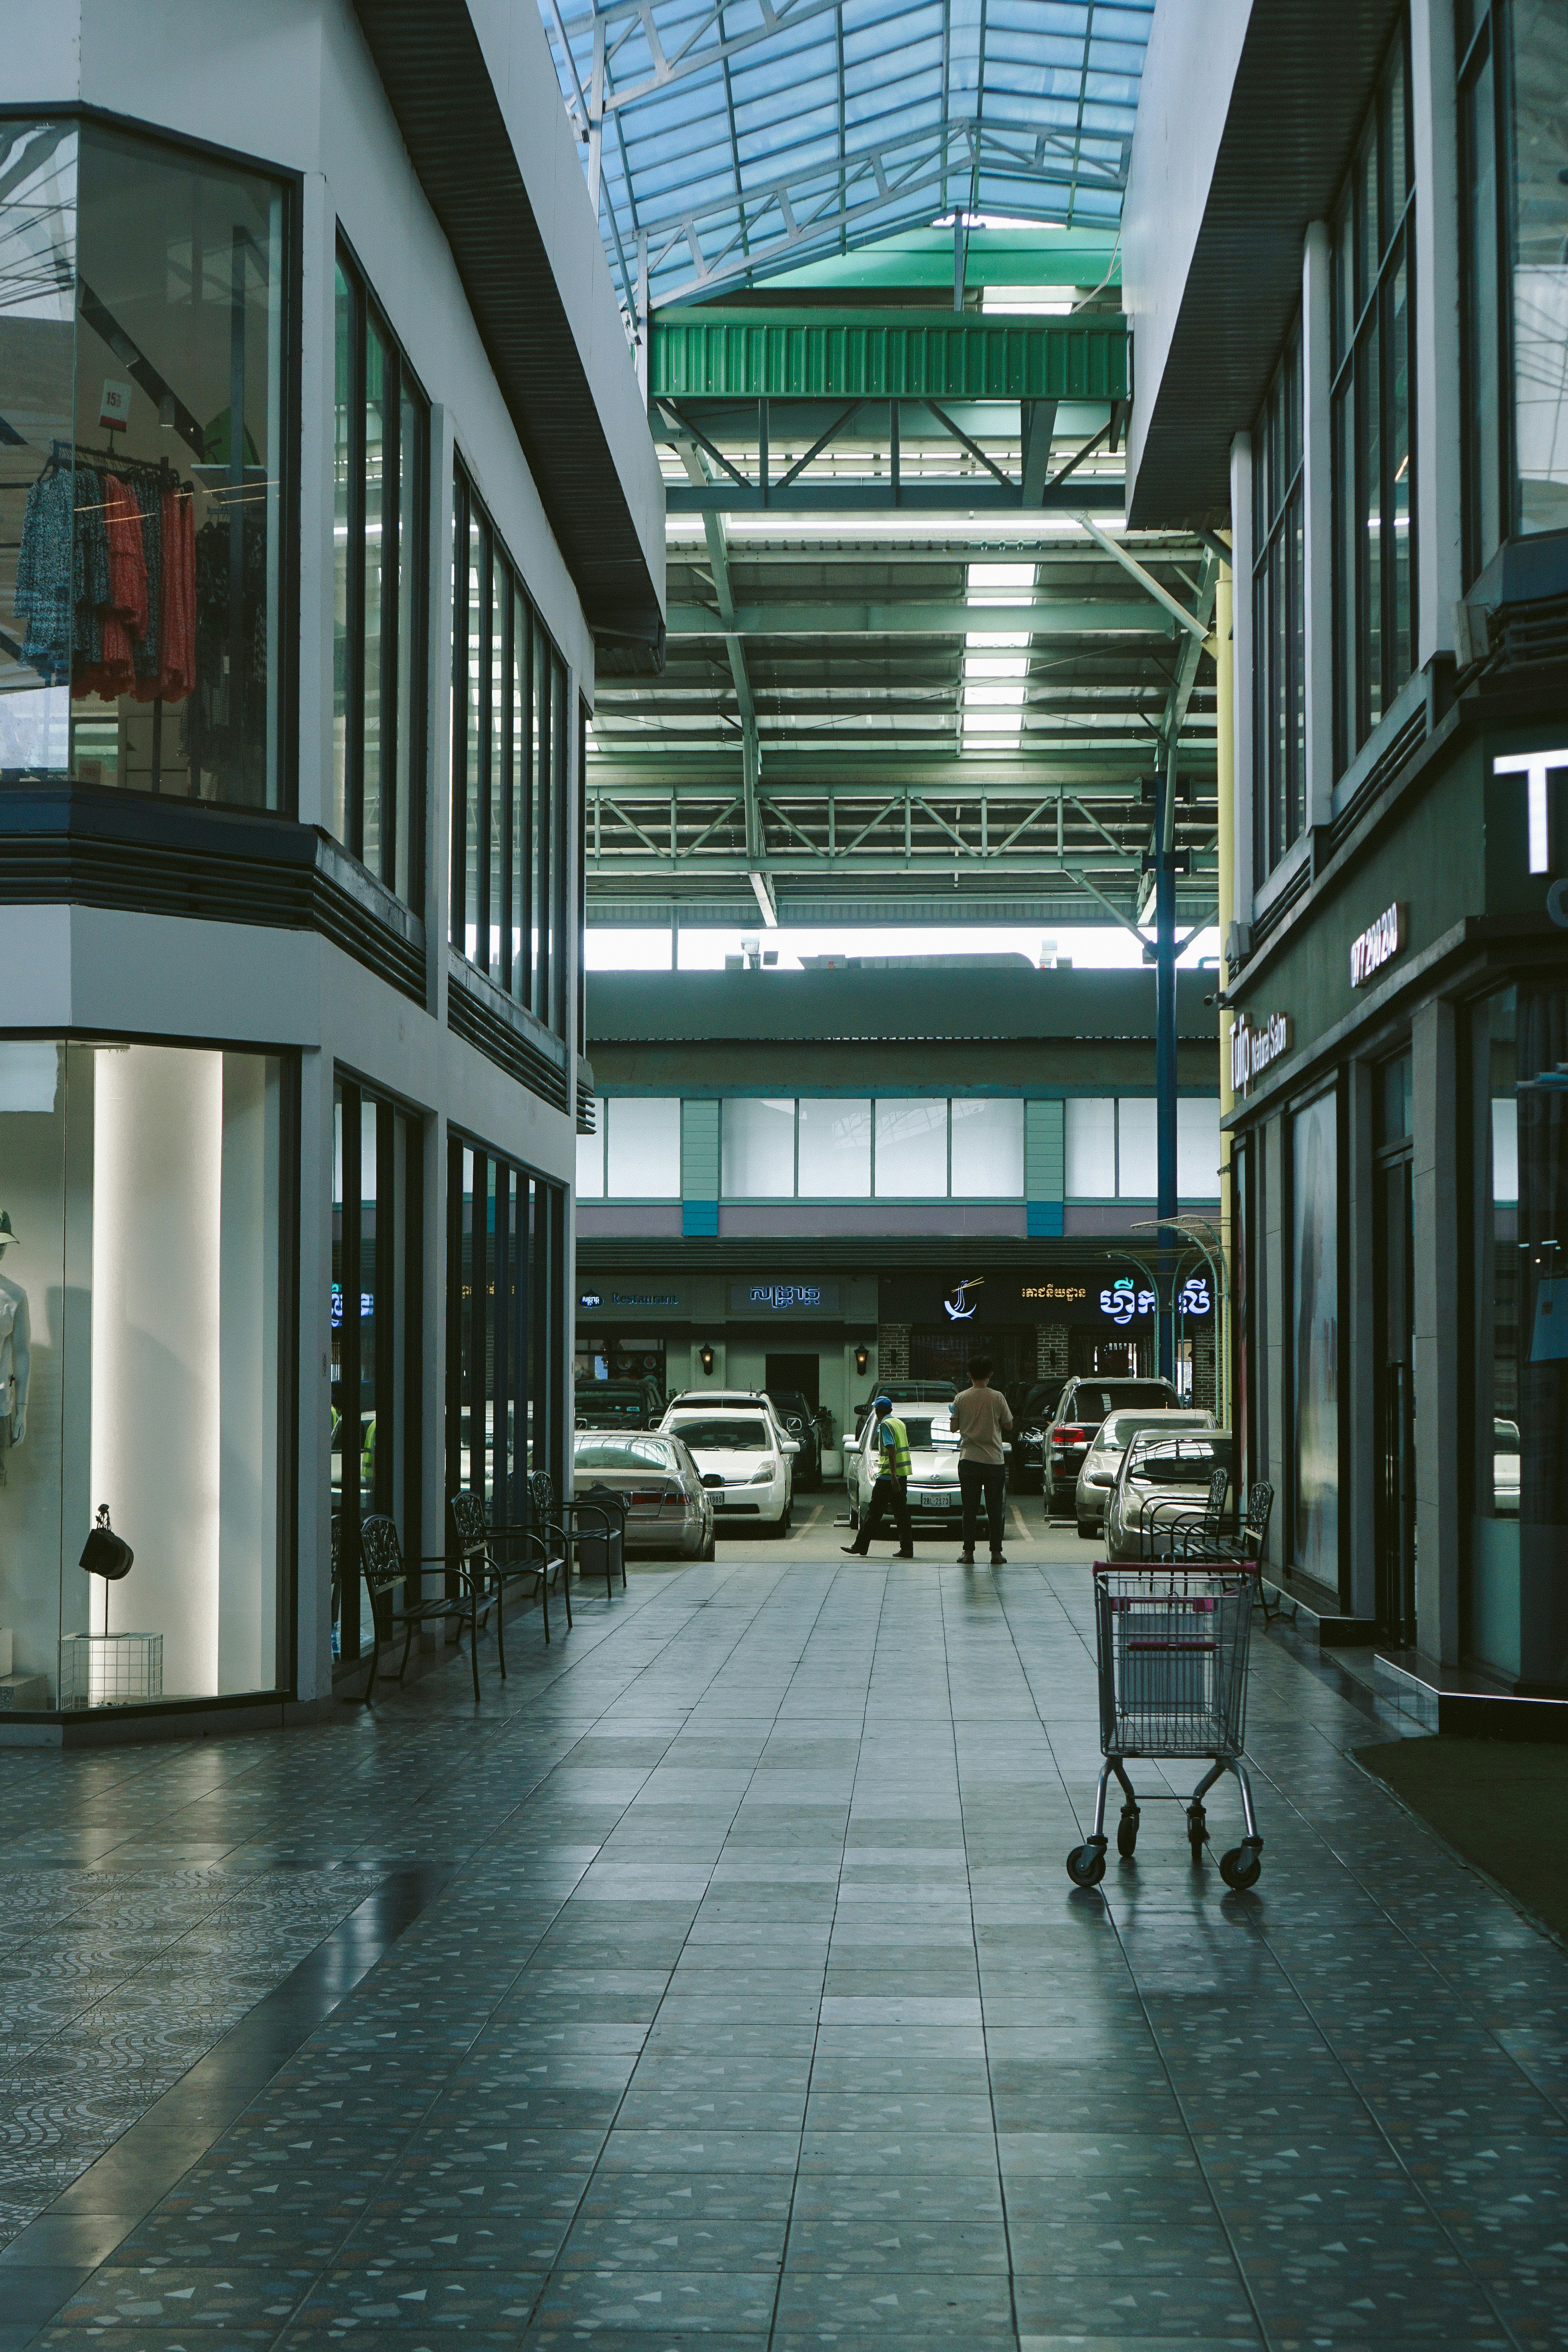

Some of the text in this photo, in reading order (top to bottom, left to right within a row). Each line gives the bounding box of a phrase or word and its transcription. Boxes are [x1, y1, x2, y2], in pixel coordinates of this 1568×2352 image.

[1230, 1013, 1250, 1100] Tulip
[1270, 1013, 1286, 1059] Salon
[612, 1293, 678, 1305] Restaurant
